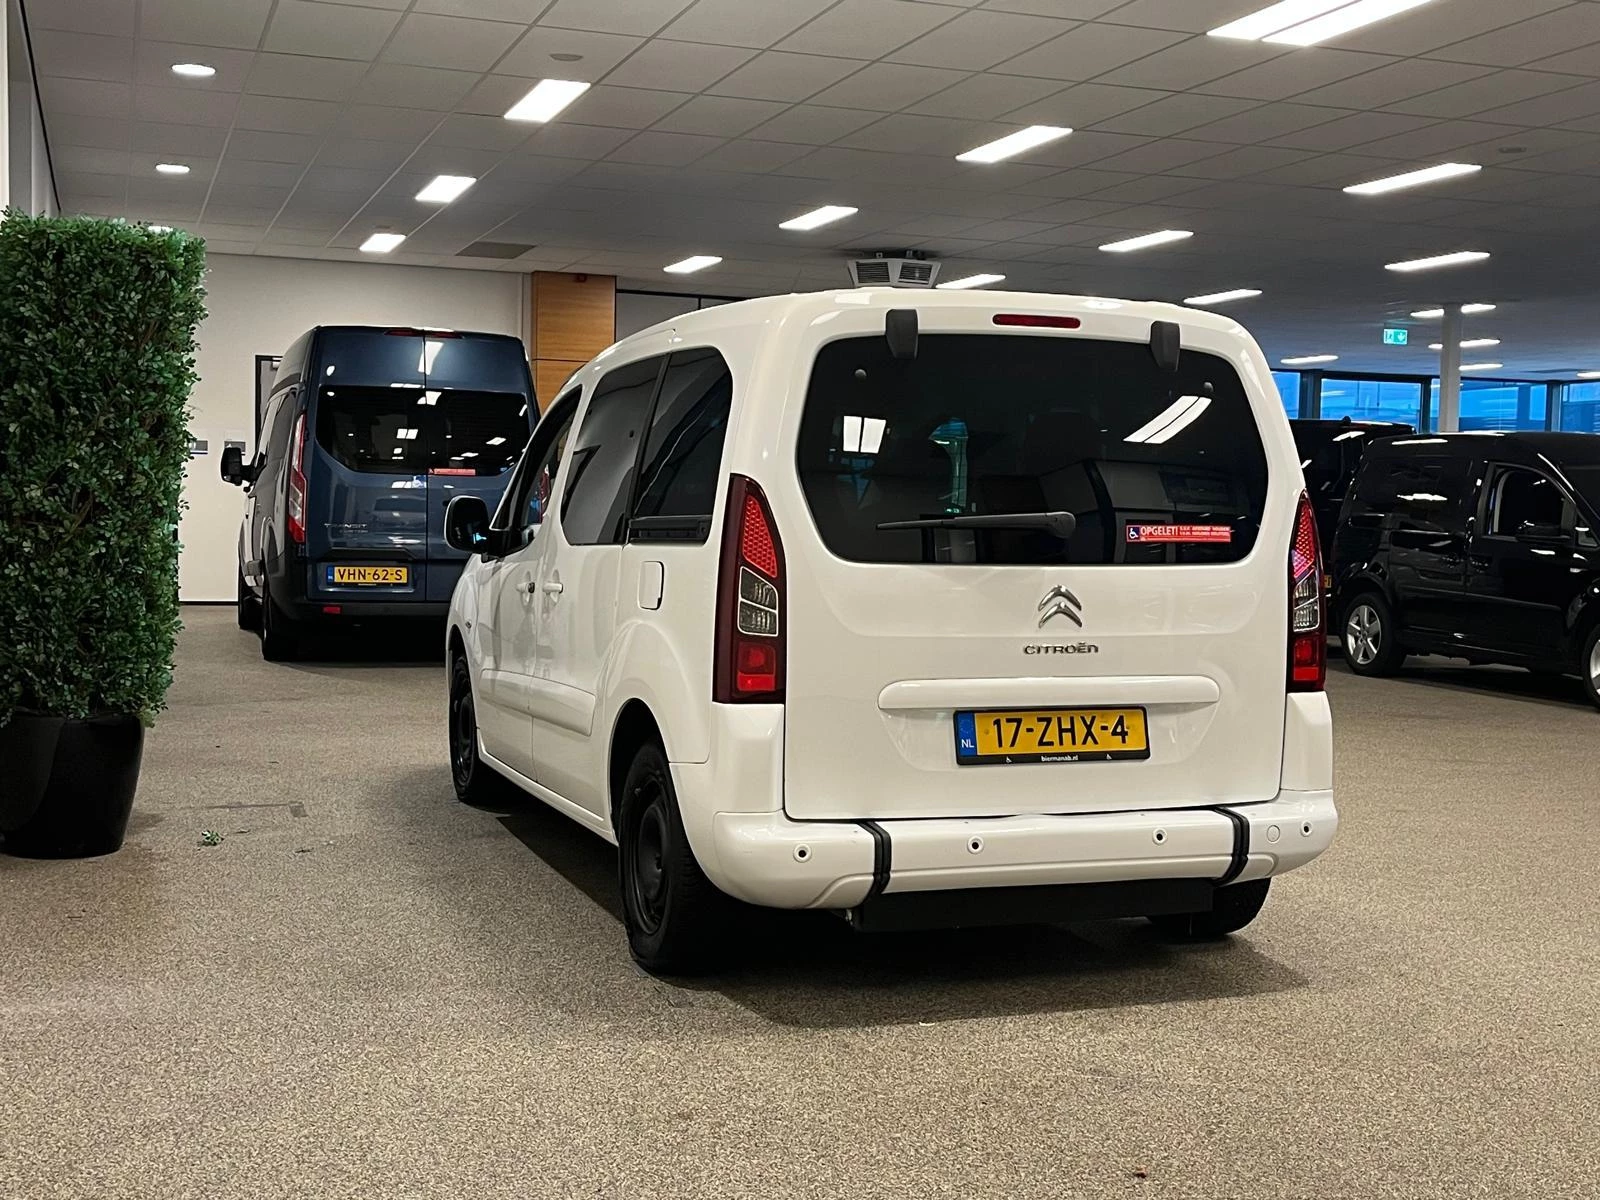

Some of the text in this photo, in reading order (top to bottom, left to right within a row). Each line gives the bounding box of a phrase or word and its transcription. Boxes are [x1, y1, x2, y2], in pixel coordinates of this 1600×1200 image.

[338, 569, 403, 581] VHN-62-S
[992, 715, 1129, 748] 17-ZHX-4
[961, 739, 975, 748] NL
